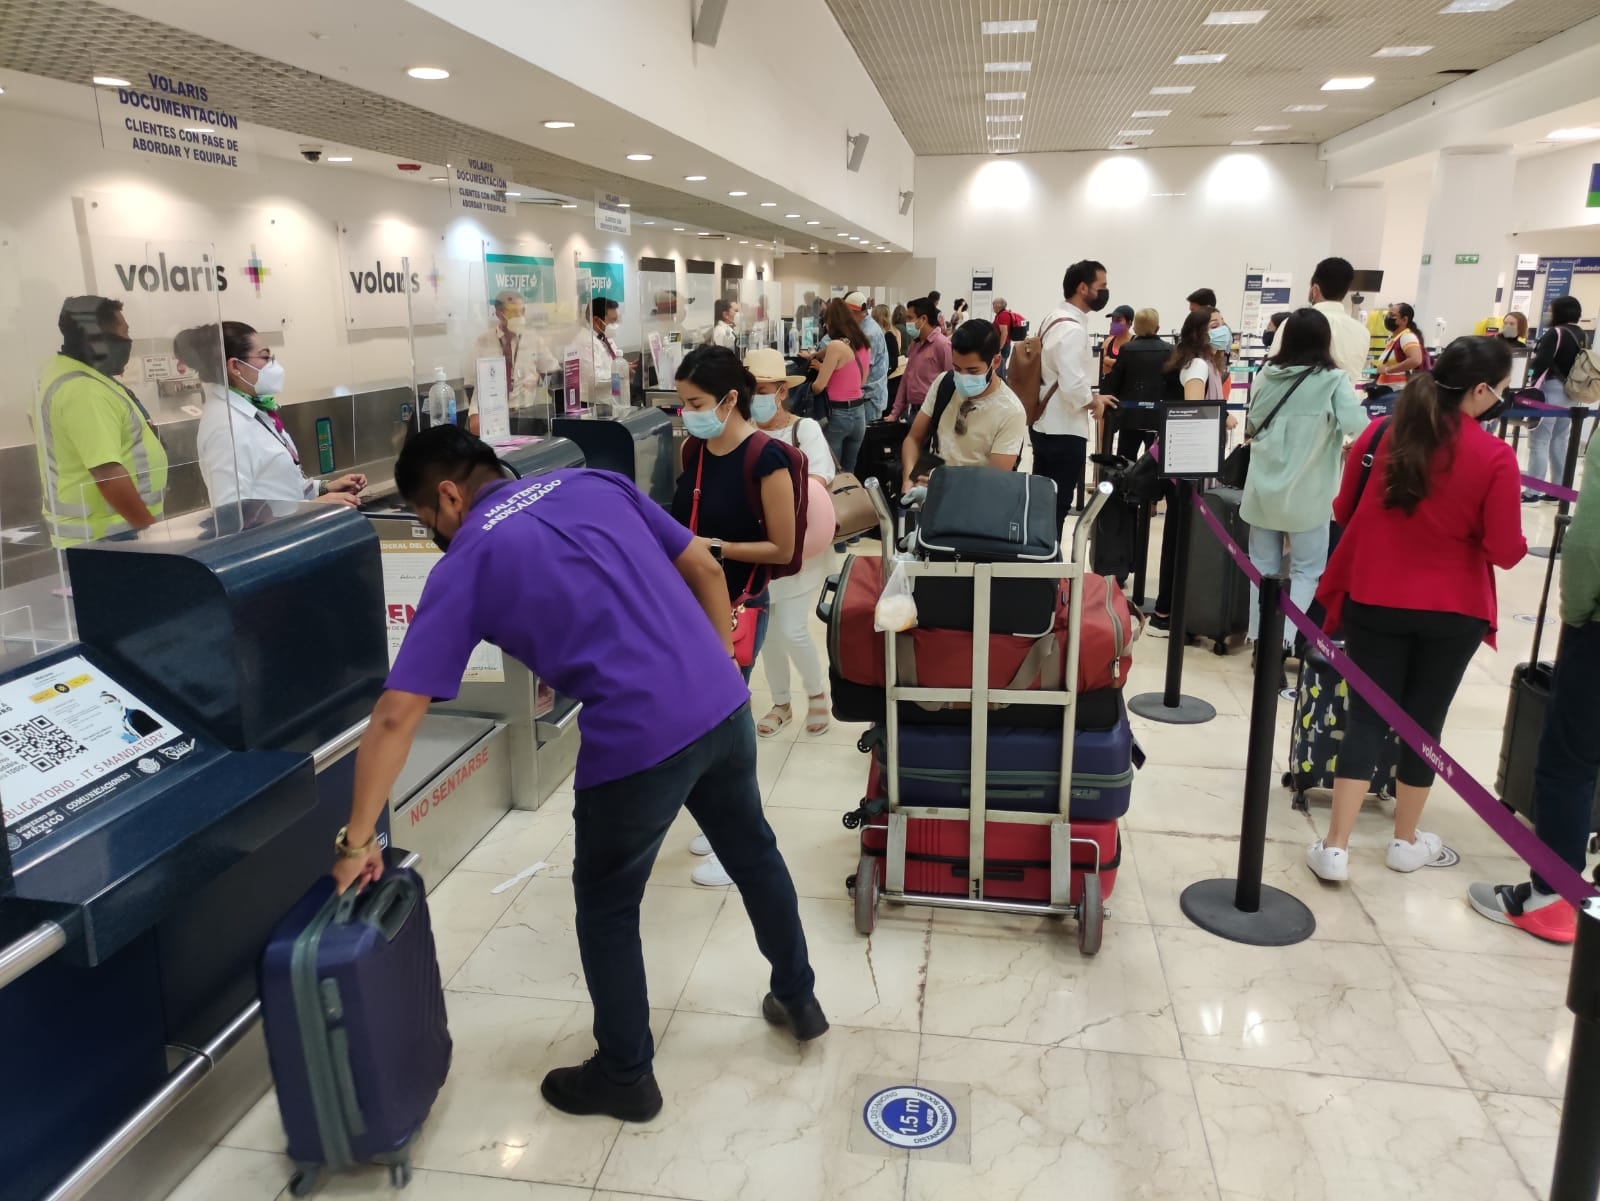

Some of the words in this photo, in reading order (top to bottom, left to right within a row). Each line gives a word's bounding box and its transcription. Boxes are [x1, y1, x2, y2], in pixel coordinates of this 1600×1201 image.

[148, 73, 208, 101] VOLARIS
[118, 88, 238, 129] DOCUMENTACIÓN
[125, 118, 176, 139] CLIENTES
[179, 129, 200, 144] CON
[202, 134, 225, 149] PASE
[227, 139, 239, 151] DE
[133, 137, 181, 157] ABORDAR
[184, 147, 190, 158] Y
[194, 149, 238, 167] EQUIPAJE
[468, 159, 494, 173] VOLARIS
[114, 252, 228, 292] volaris
[495, 274, 531, 291] WESTJET
[482, 480, 561, 531] SINDICALIZADO
[484, 483, 542, 518] MALETERO
[1422, 742, 1444, 772] volaris
[3, 779, 75, 822] BLIGATORIO
[66, 772, 131, 810] COMUNICACIONES
[411, 799, 429, 827] NO
[432, 746, 489, 807] SENTARSE
[906, 1099, 920, 1113] m
[899, 1116, 919, 1135] 1.5
